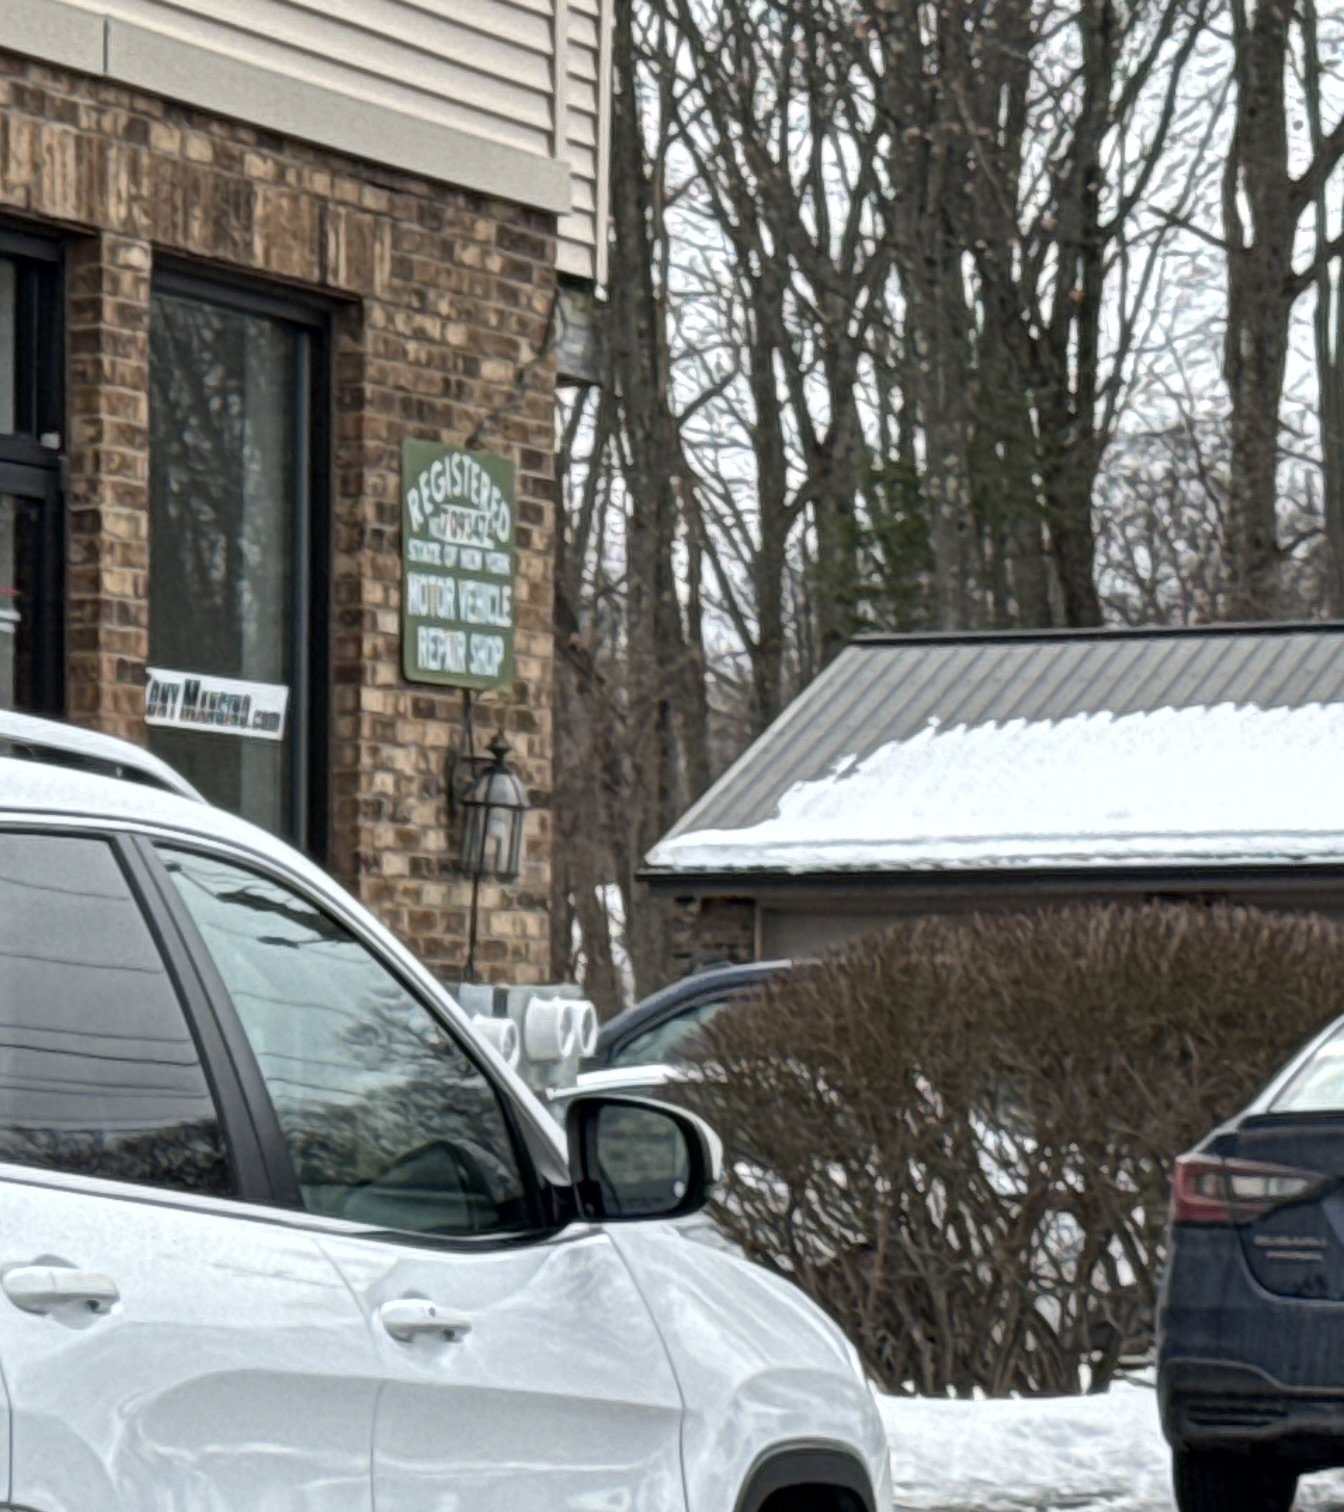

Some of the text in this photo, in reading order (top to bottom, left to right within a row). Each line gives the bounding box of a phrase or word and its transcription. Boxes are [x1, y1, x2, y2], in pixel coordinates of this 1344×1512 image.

[407, 452, 511, 543] REGISTERED
[407, 571, 512, 628] MOTOR VEHICLE
[417, 625, 505, 677] REPAIR SHOP
